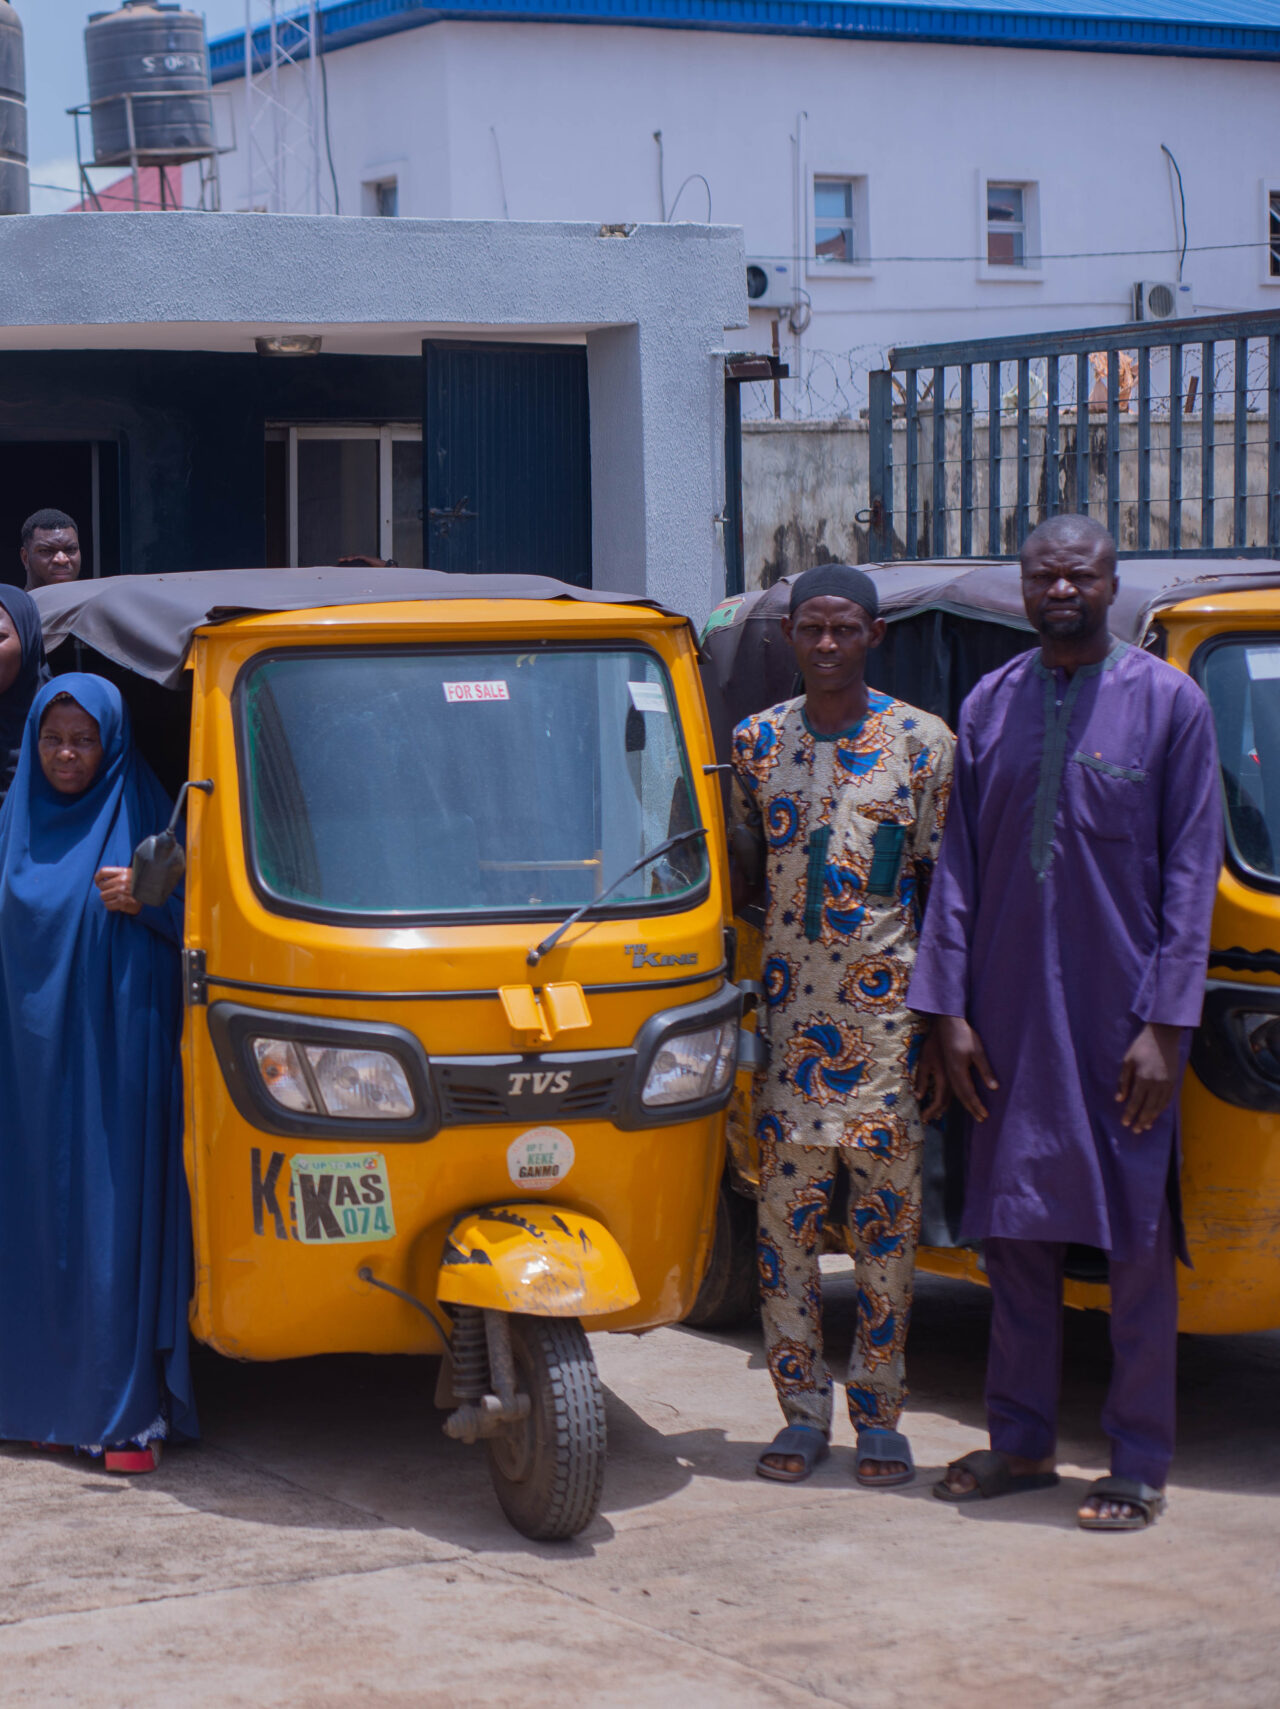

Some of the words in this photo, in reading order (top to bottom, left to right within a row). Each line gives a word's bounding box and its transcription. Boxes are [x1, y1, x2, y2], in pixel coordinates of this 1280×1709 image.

[448, 685, 472, 699] FOR
[475, 684, 505, 698] SALE
[508, 1071, 572, 1096] TVS
[519, 1165, 559, 1178] GANMO
[343, 1206, 390, 1235] 074
